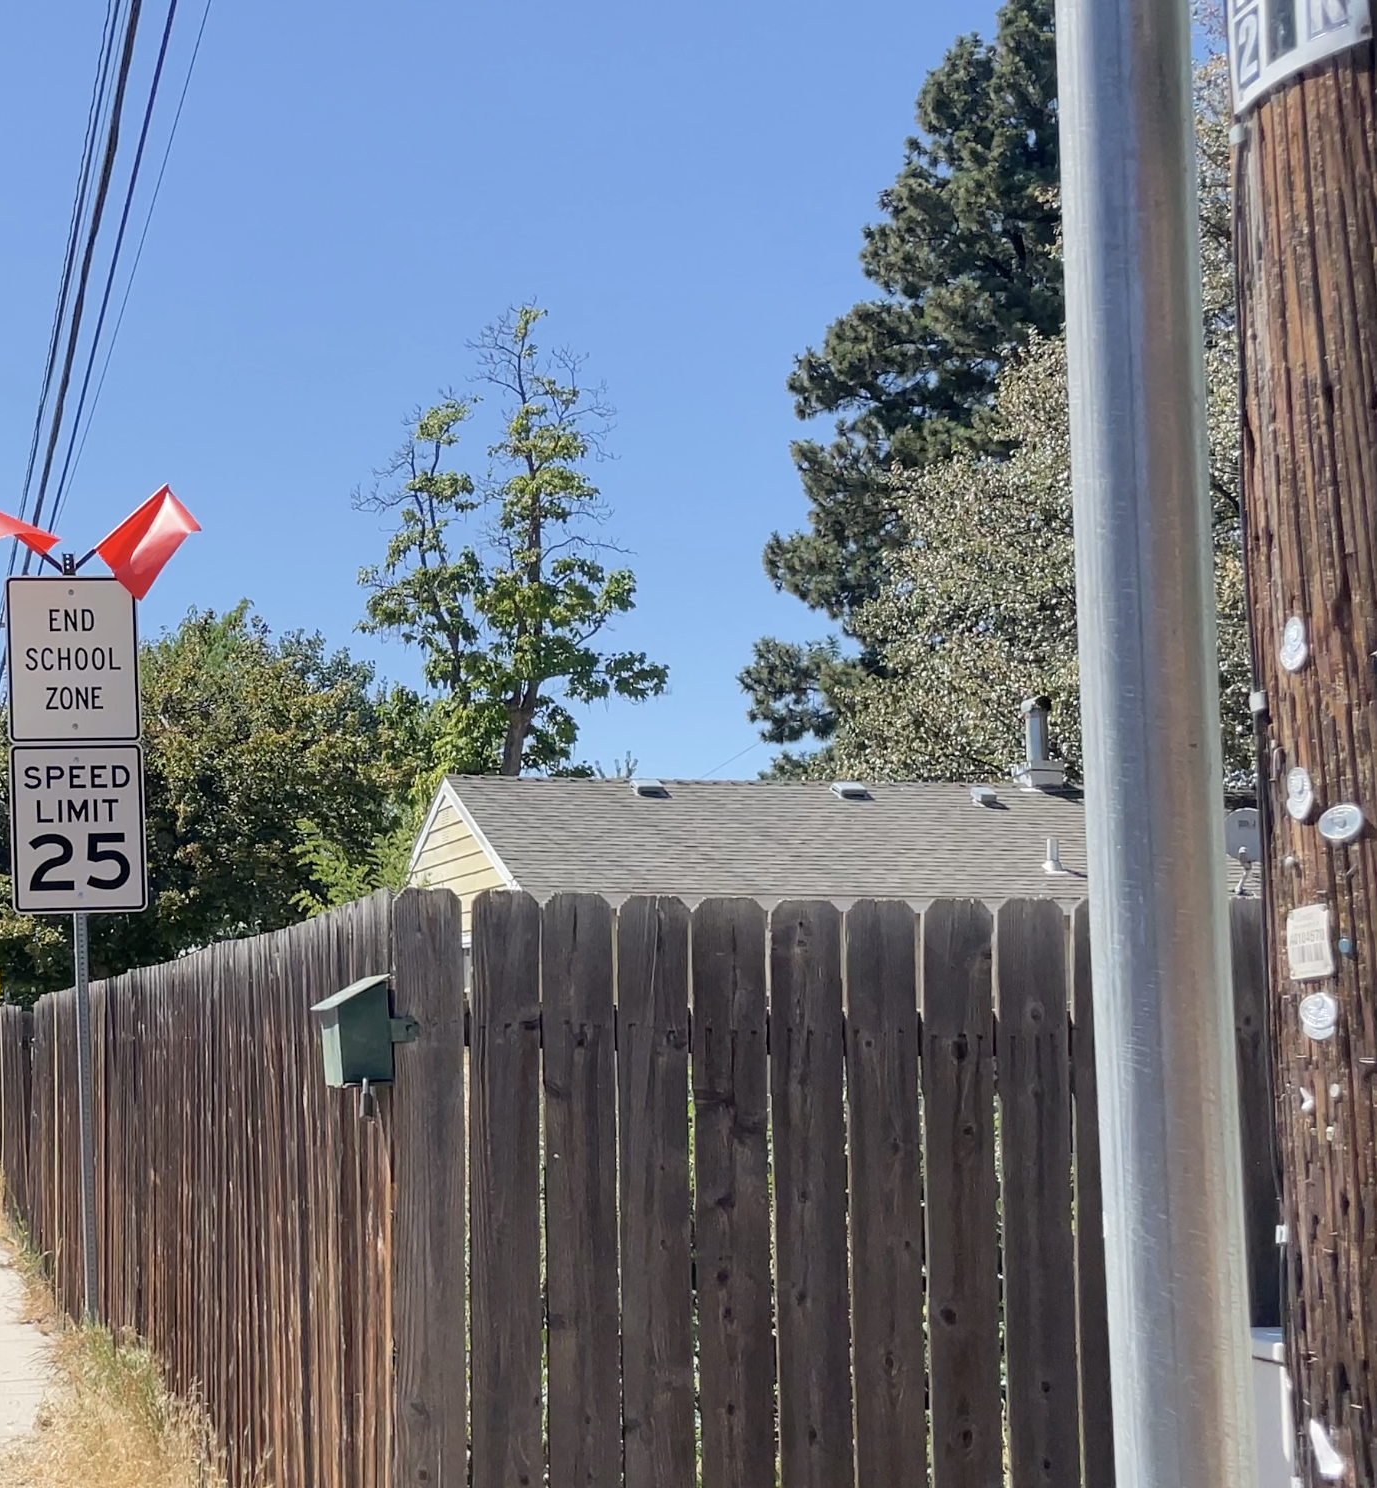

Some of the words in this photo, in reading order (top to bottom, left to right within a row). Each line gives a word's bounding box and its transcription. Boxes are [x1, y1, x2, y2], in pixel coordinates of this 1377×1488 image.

[49, 609, 94, 631] END
[26, 647, 121, 671] SCHOOL
[46, 687, 103, 710] ZONE
[24, 765, 130, 789] SPEED
[37, 799, 118, 823] LIMIT
[29, 833, 130, 891] 25
